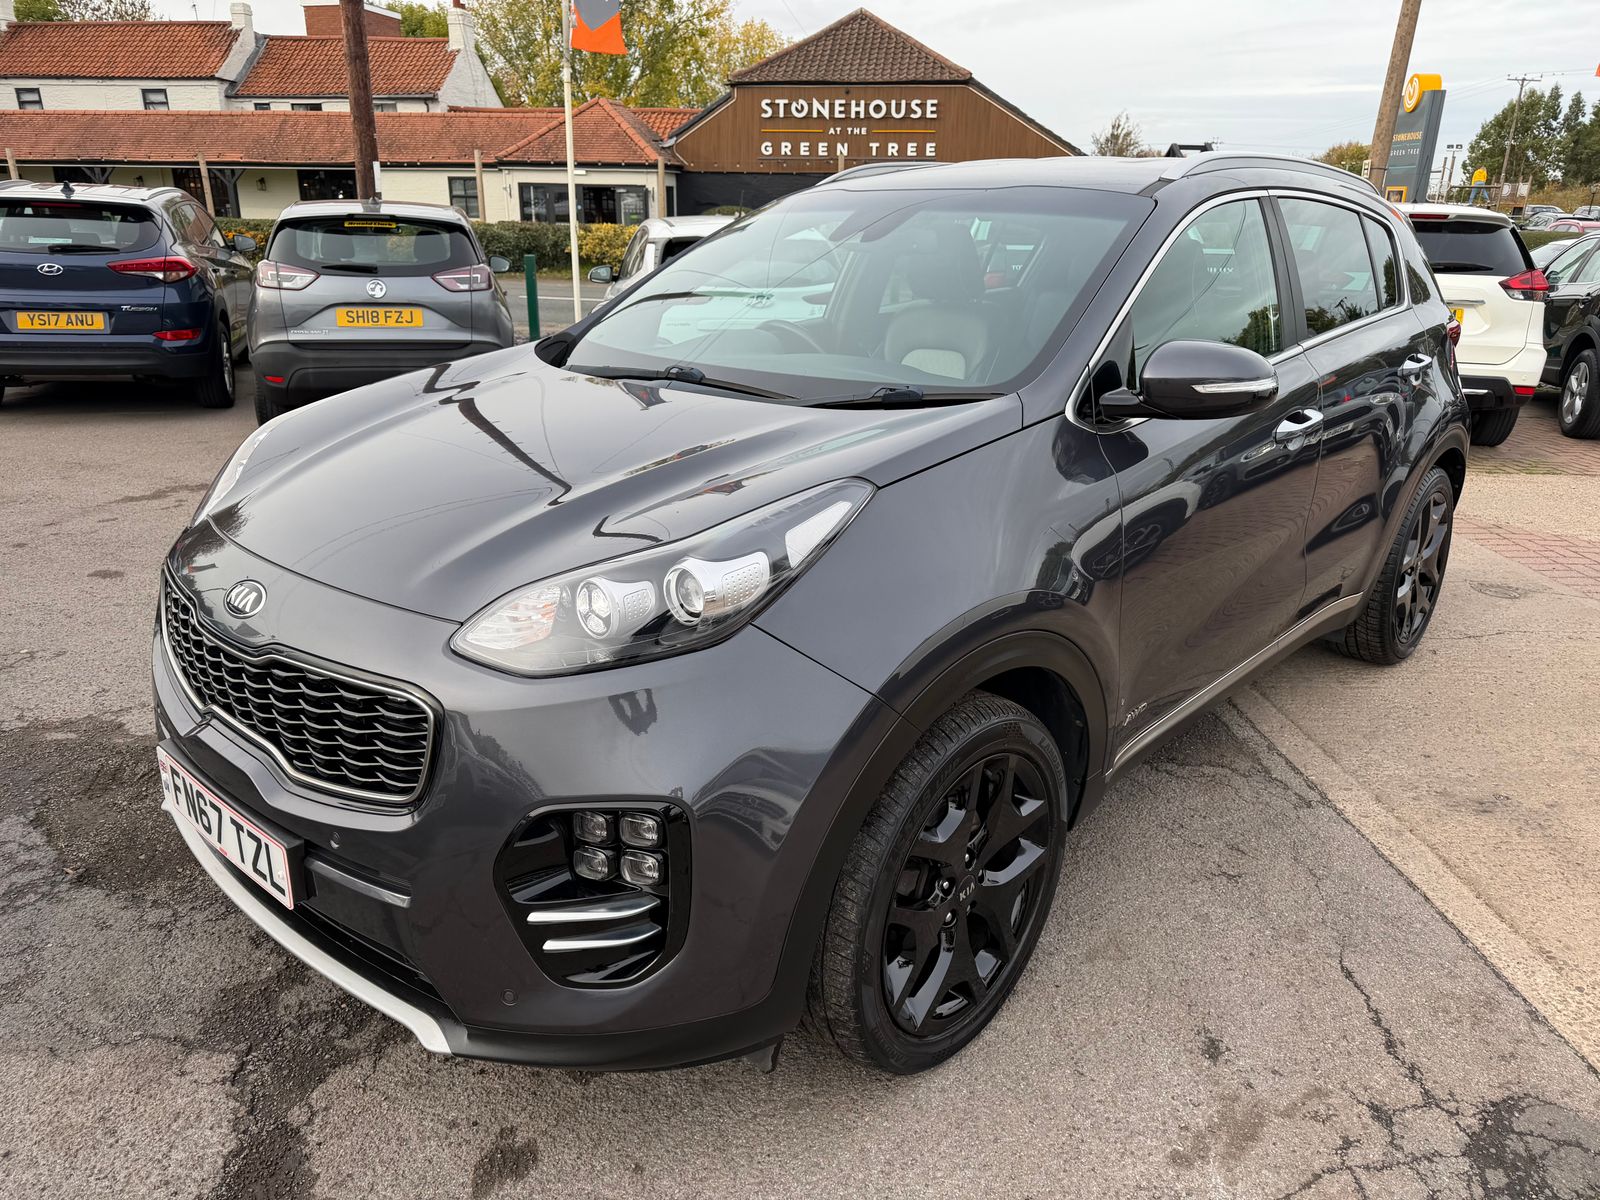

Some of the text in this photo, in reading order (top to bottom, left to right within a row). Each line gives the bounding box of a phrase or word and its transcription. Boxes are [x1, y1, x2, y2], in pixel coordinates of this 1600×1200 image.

[760, 97, 938, 121] STONEHOUSE
[828, 127, 868, 135] AT THE
[1392, 131, 1422, 142] STONEHOUSE
[760, 141, 937, 157] GREEN TREE
[27, 313, 94, 327] YS17 ANU
[345, 310, 414, 324] SH18 FZJ
[227, 585, 258, 613] KIA
[169, 764, 286, 897] FN67 TZL
[959, 882, 976, 902] KIA
